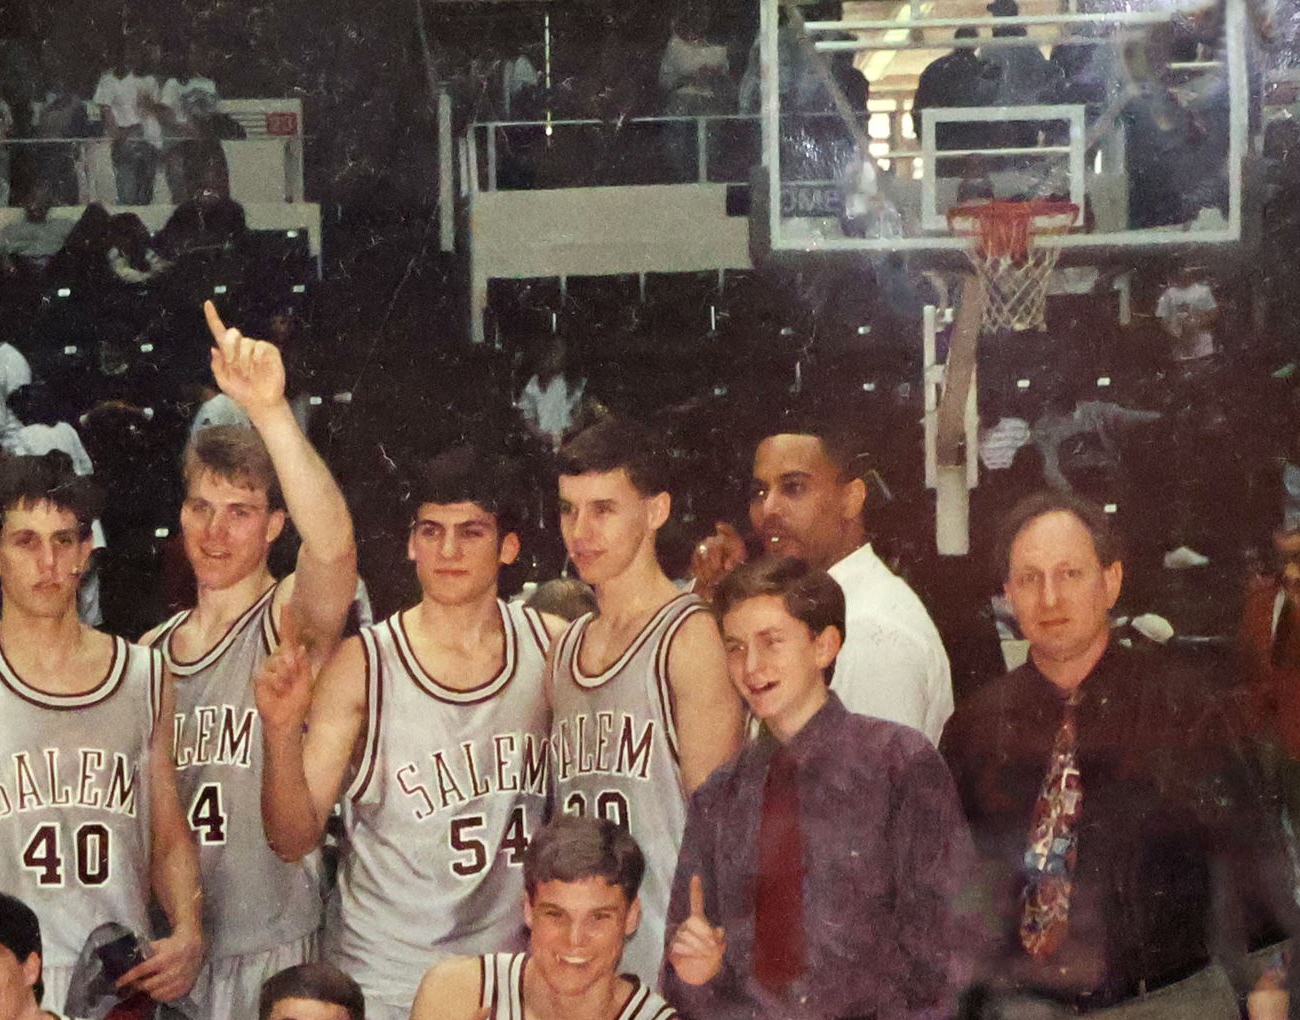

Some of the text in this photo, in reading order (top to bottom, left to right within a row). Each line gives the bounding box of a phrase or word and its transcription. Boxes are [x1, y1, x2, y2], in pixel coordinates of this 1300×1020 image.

[396, 731, 550, 822] SALEM
[23, 822, 112, 888] 40
[449, 804, 530, 878] 54
